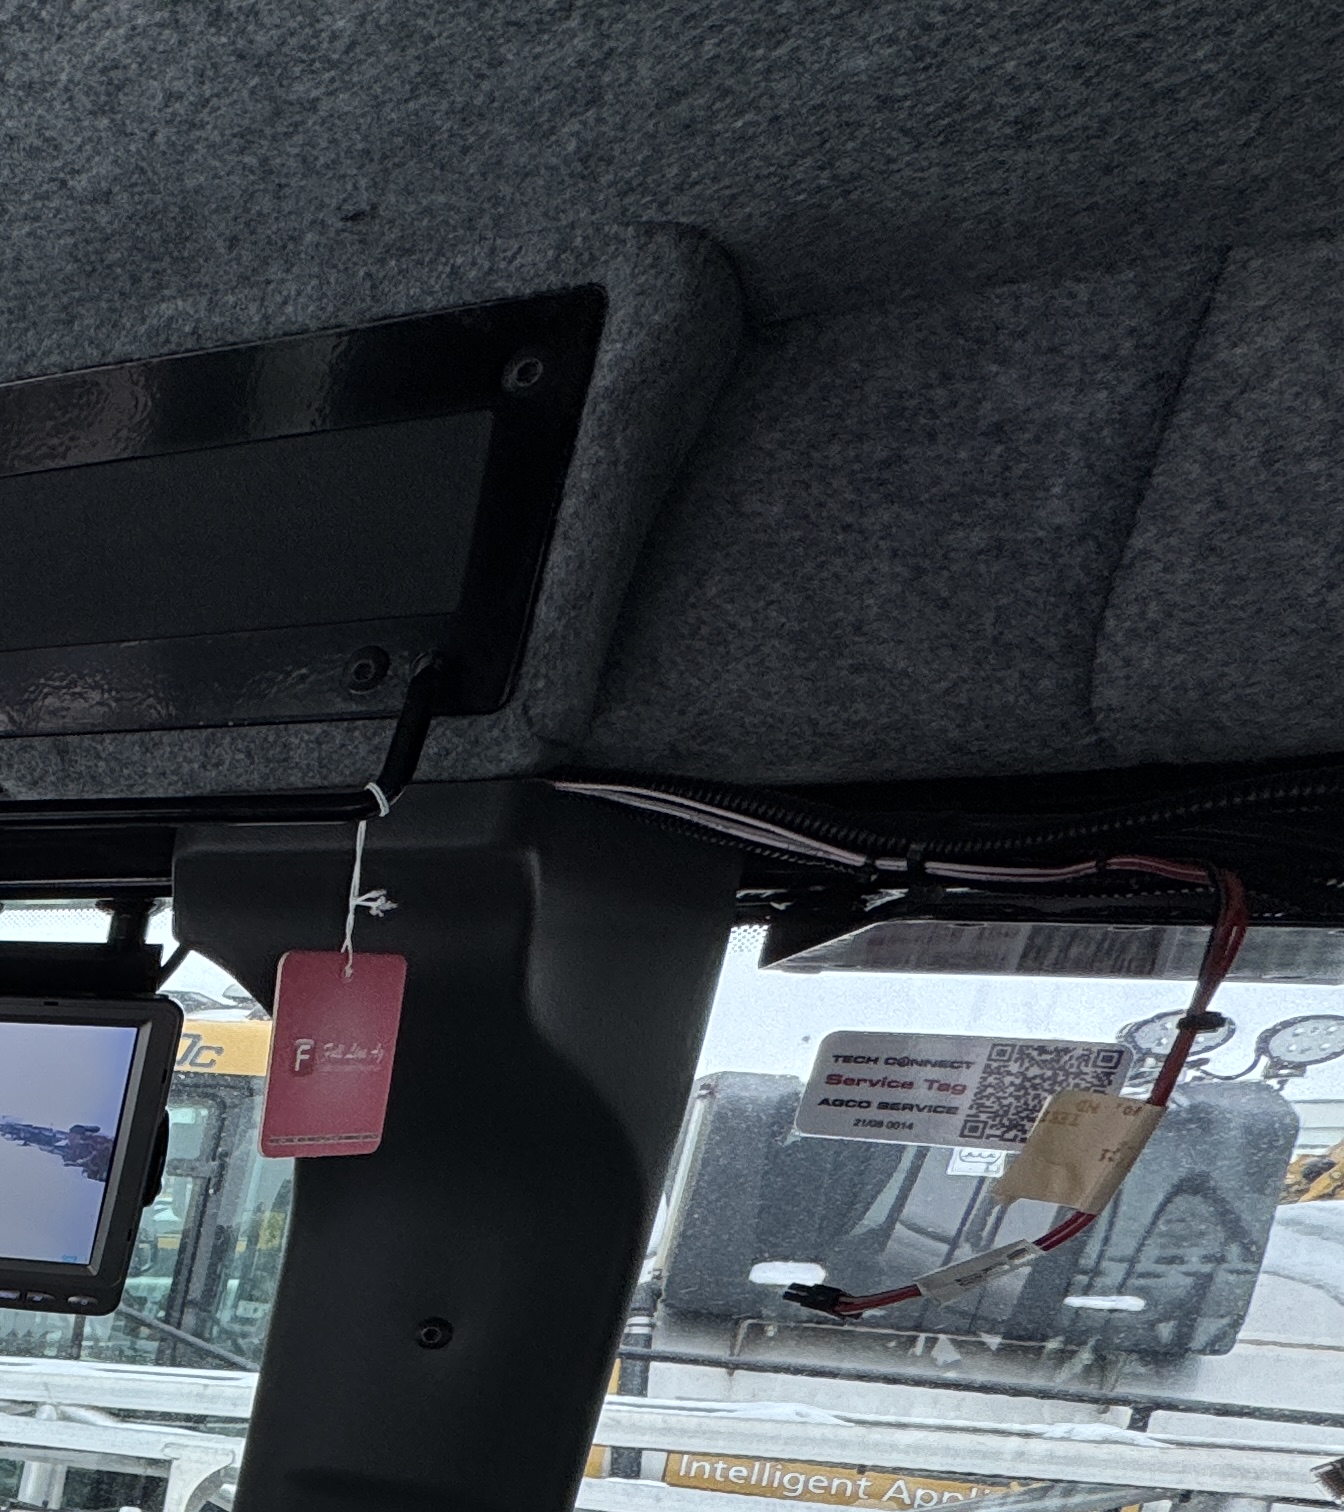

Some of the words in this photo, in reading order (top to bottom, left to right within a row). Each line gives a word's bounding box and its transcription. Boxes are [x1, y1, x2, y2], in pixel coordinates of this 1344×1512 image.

[832, 1054, 880, 1066] TECH
[883, 1056, 976, 1070] CONNECT
[824, 1073, 915, 1091] Service
[922, 1077, 968, 1097] Tag
[817, 1097, 872, 1110] AGCO
[876, 1101, 960, 1116] SERVICE
[678, 1453, 872, 1500] Intelligent
